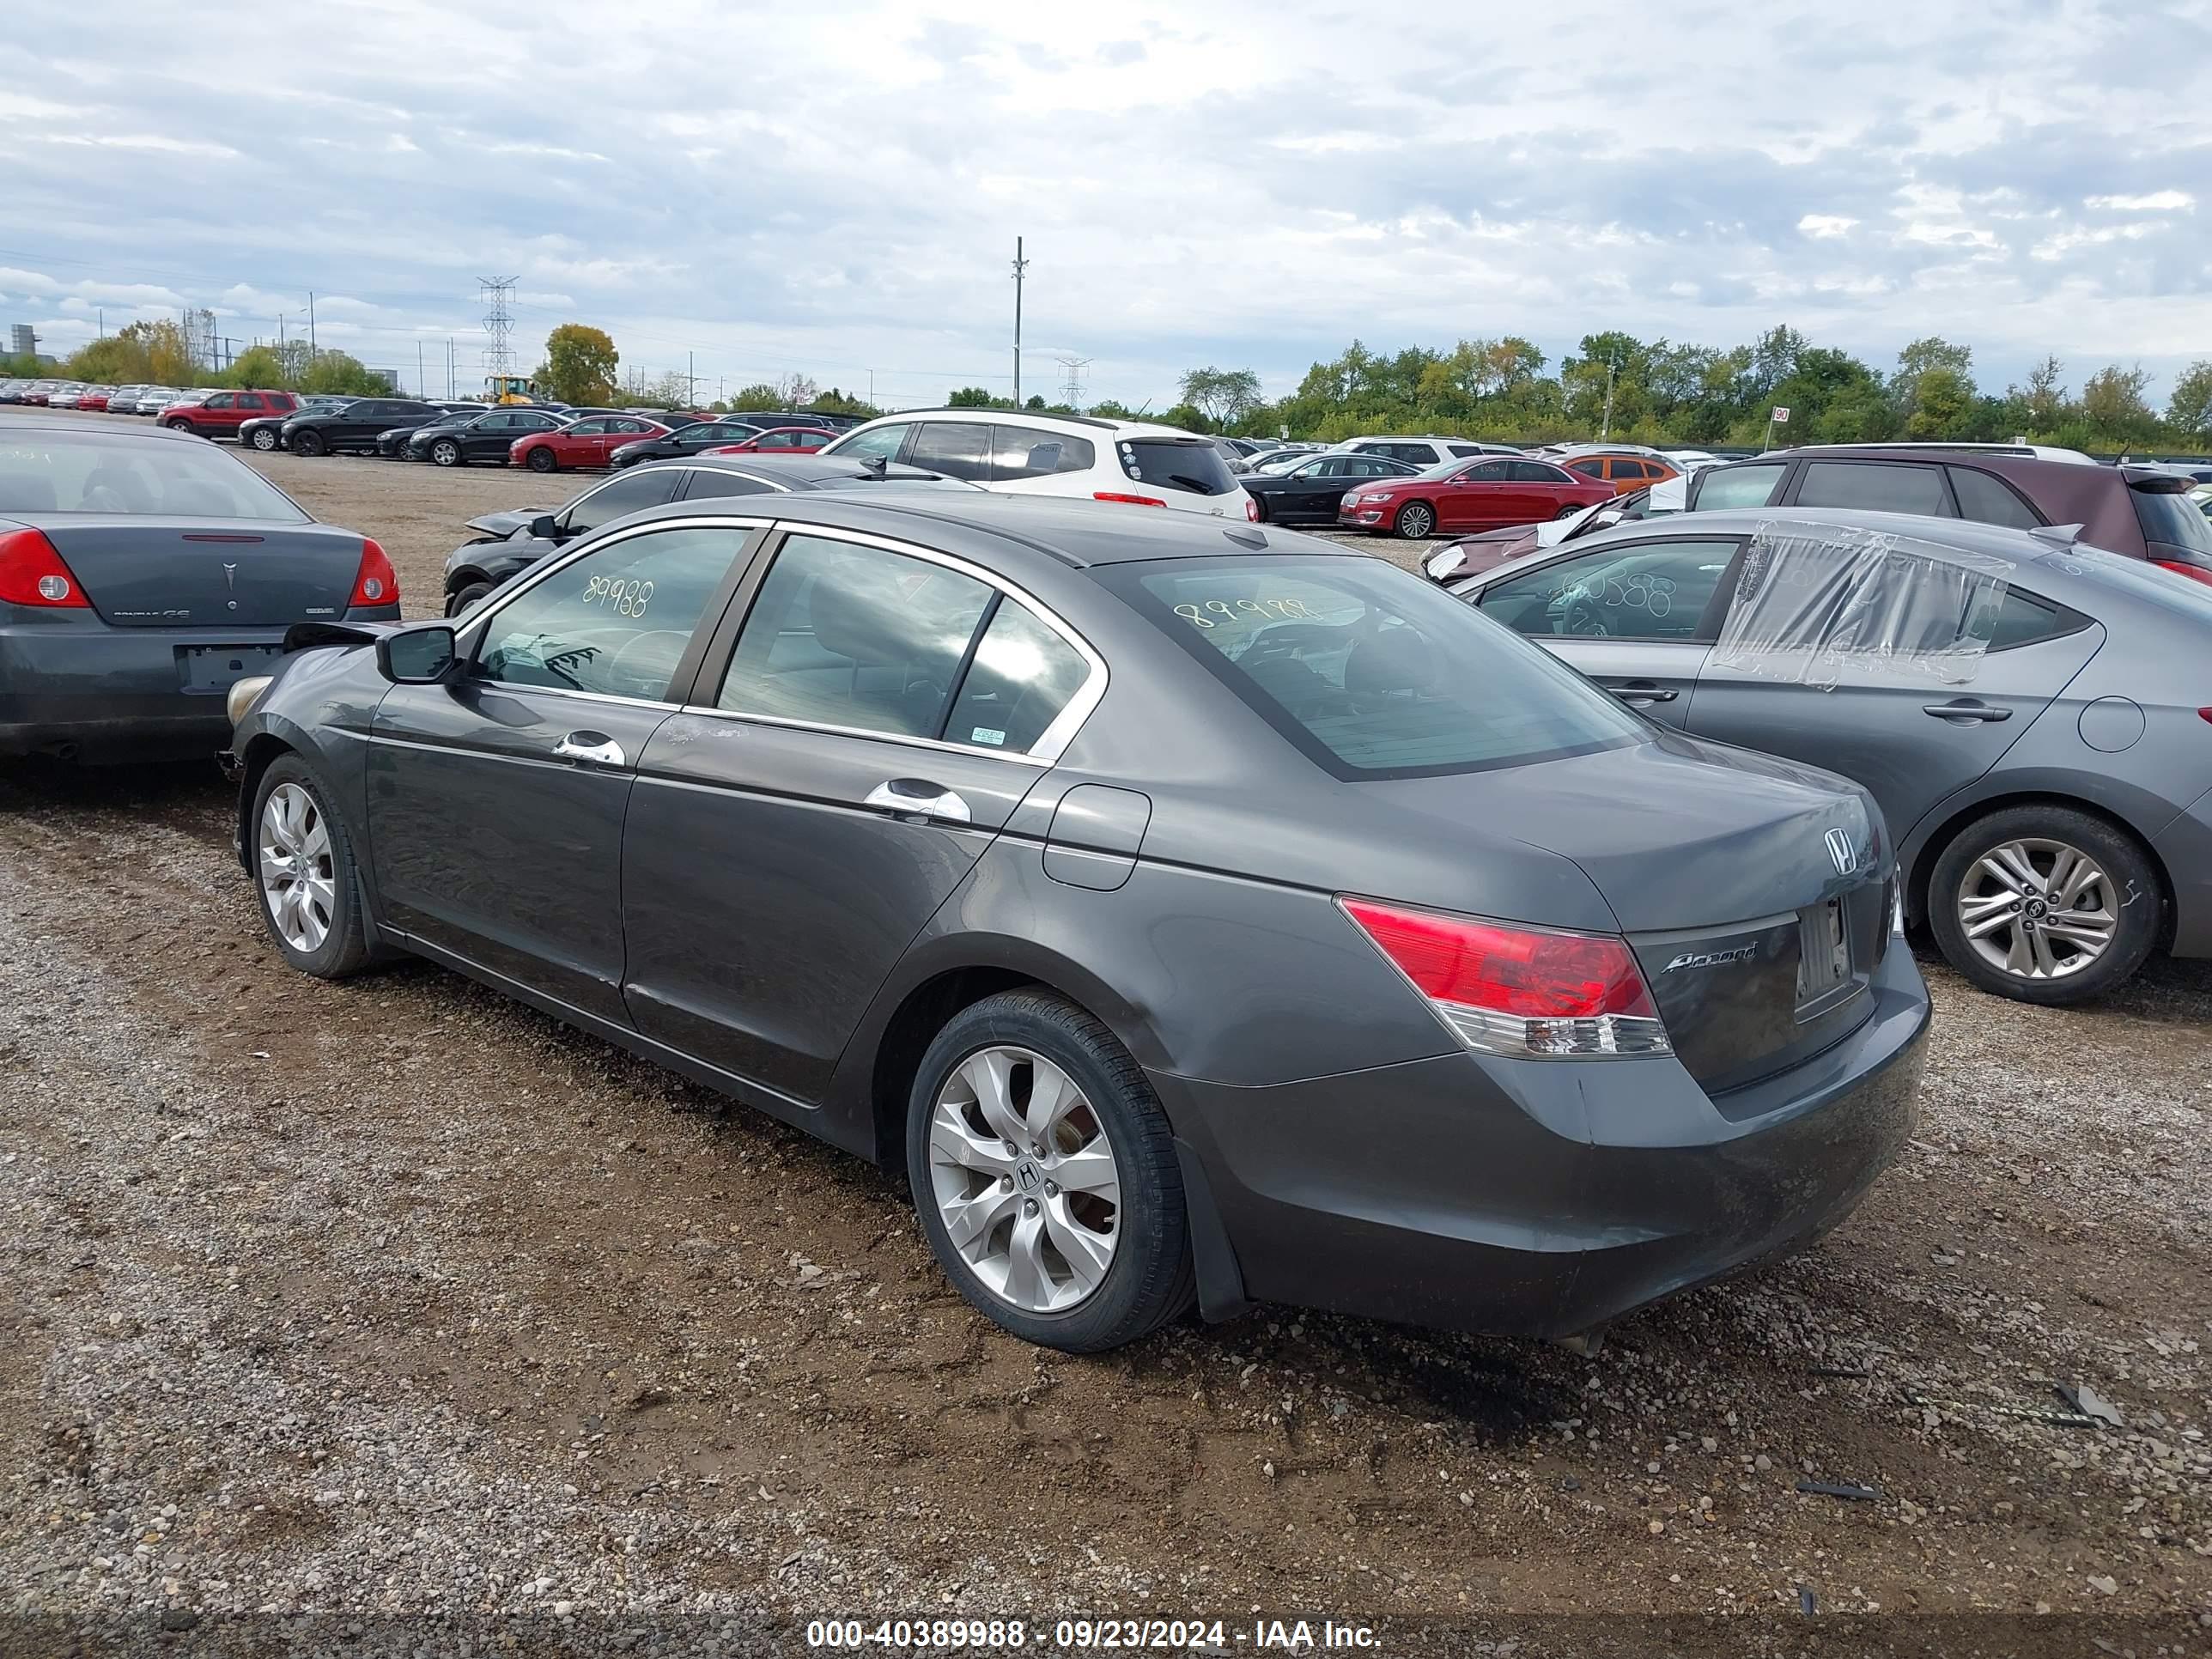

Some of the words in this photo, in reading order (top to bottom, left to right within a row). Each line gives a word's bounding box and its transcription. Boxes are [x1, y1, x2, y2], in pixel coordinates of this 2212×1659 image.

[582, 573, 654, 618] 89988
[1173, 599, 1324, 629] 89988
[1660, 941, 1759, 974] Accord
